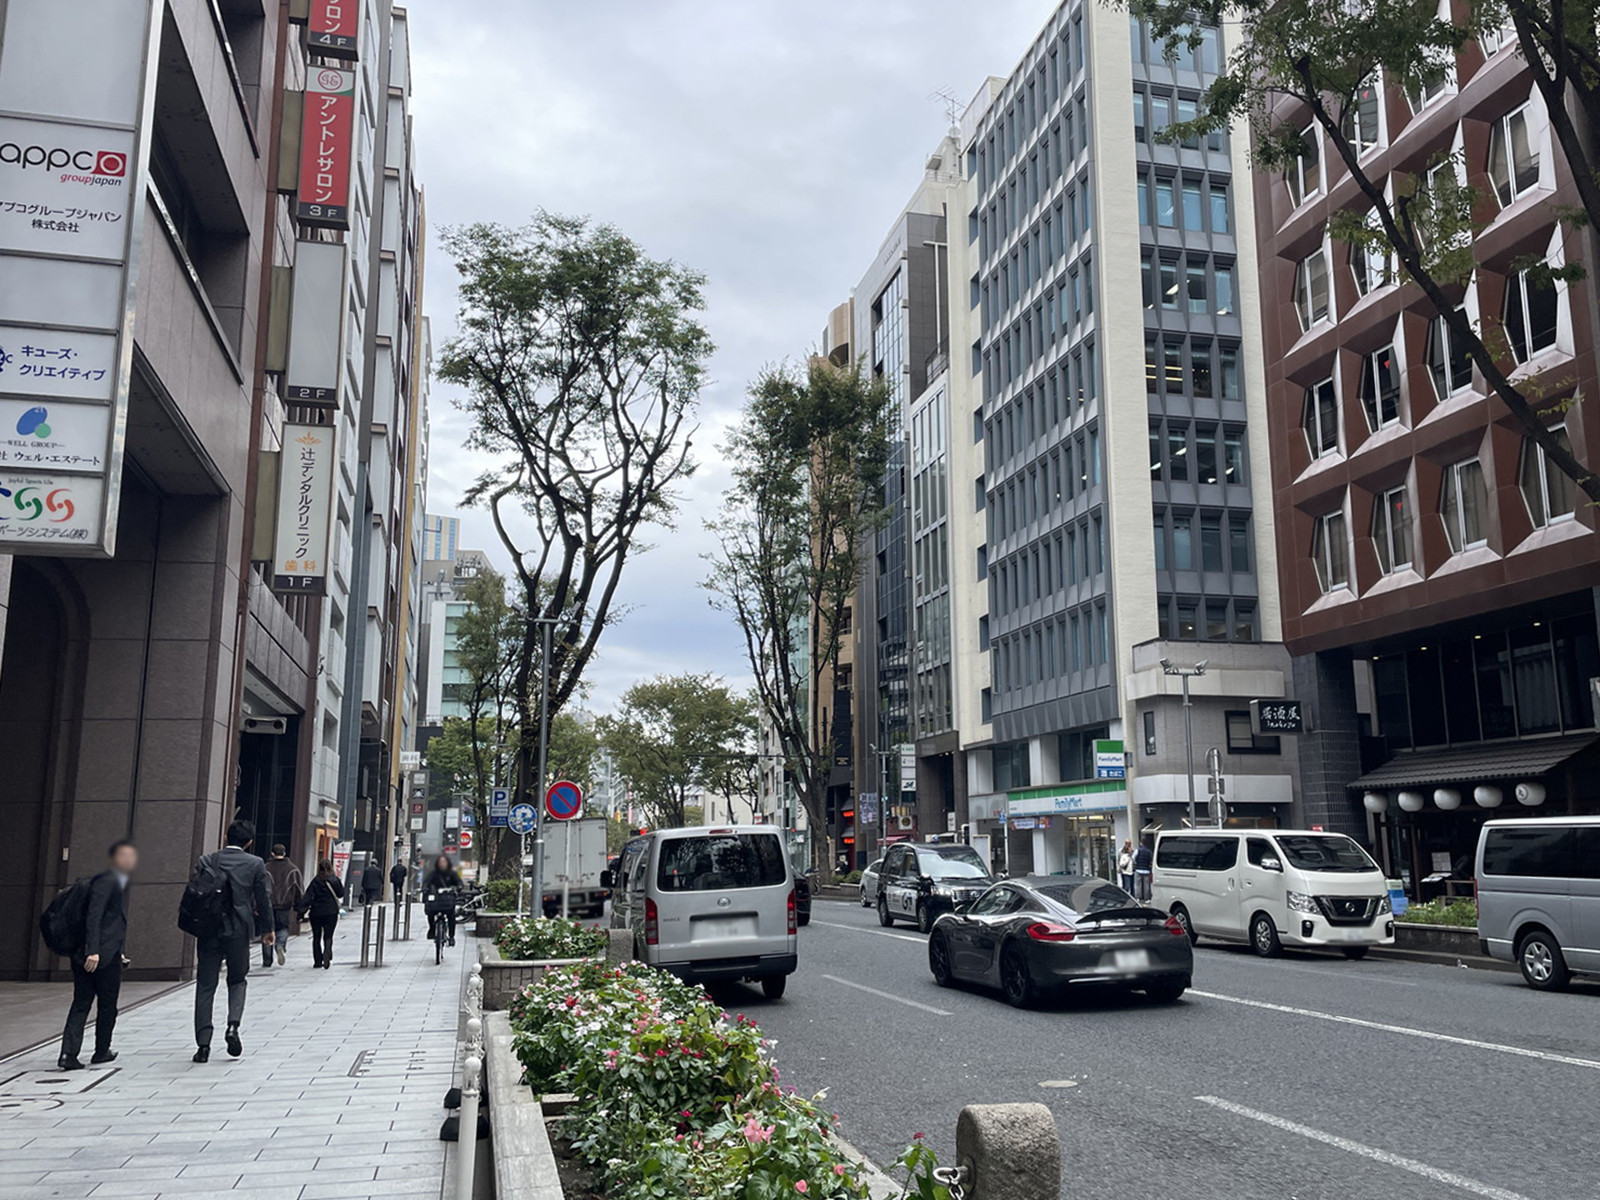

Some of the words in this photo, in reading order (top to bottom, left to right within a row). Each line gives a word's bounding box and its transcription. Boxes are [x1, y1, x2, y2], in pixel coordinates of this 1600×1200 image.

[324, 0, 341, 33] ロン
[315, 95, 338, 202] アントレサロン
[60, 173, 122, 187] groupjapan
[0, 202, 122, 222] プコグループジャパン
[31, 218, 80, 233] 株式会社
[19, 364, 106, 381] クリエイティブ
[295, 447, 316, 559] 辻デンタルクリニック
[284, 559, 317, 572] 歯科
[1261, 705, 1301, 720] 居酒屋
[494, 791, 507, 806] P
[1054, 797, 1083, 810] FamilyMart
